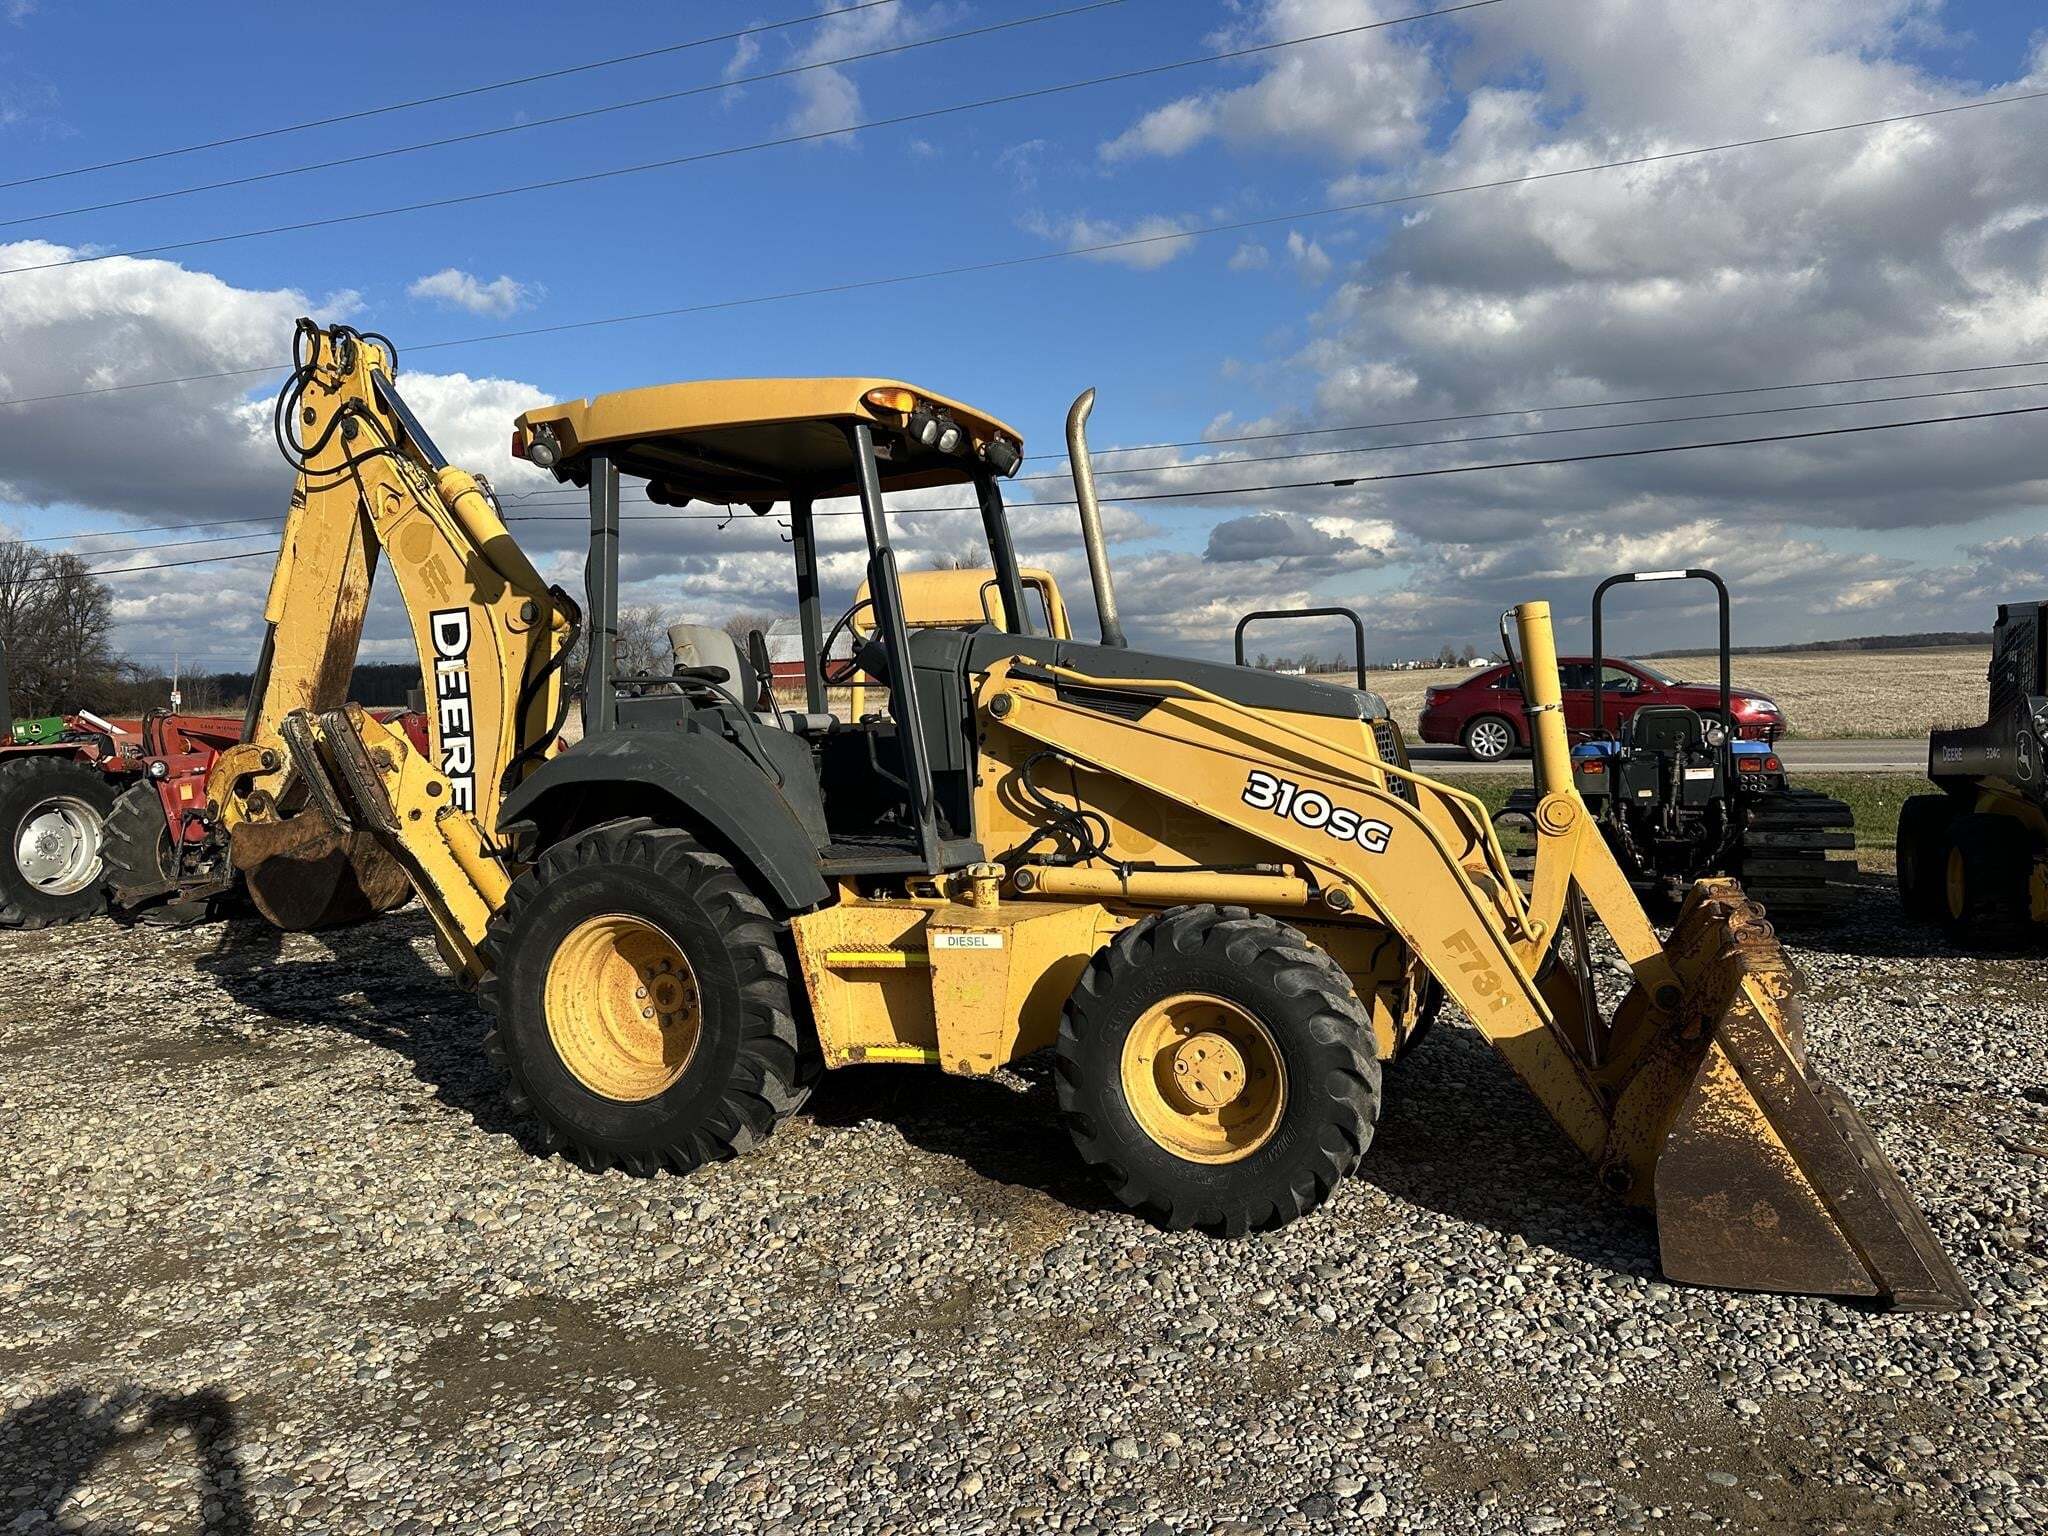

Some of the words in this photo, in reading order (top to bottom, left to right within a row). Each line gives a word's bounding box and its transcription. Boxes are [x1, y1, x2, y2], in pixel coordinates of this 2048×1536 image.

[431, 609, 475, 813] DEERE
[1942, 745, 1963, 762] DEERE
[1242, 770, 1393, 854] 310SG
[948, 936, 988, 947] DIESEL
